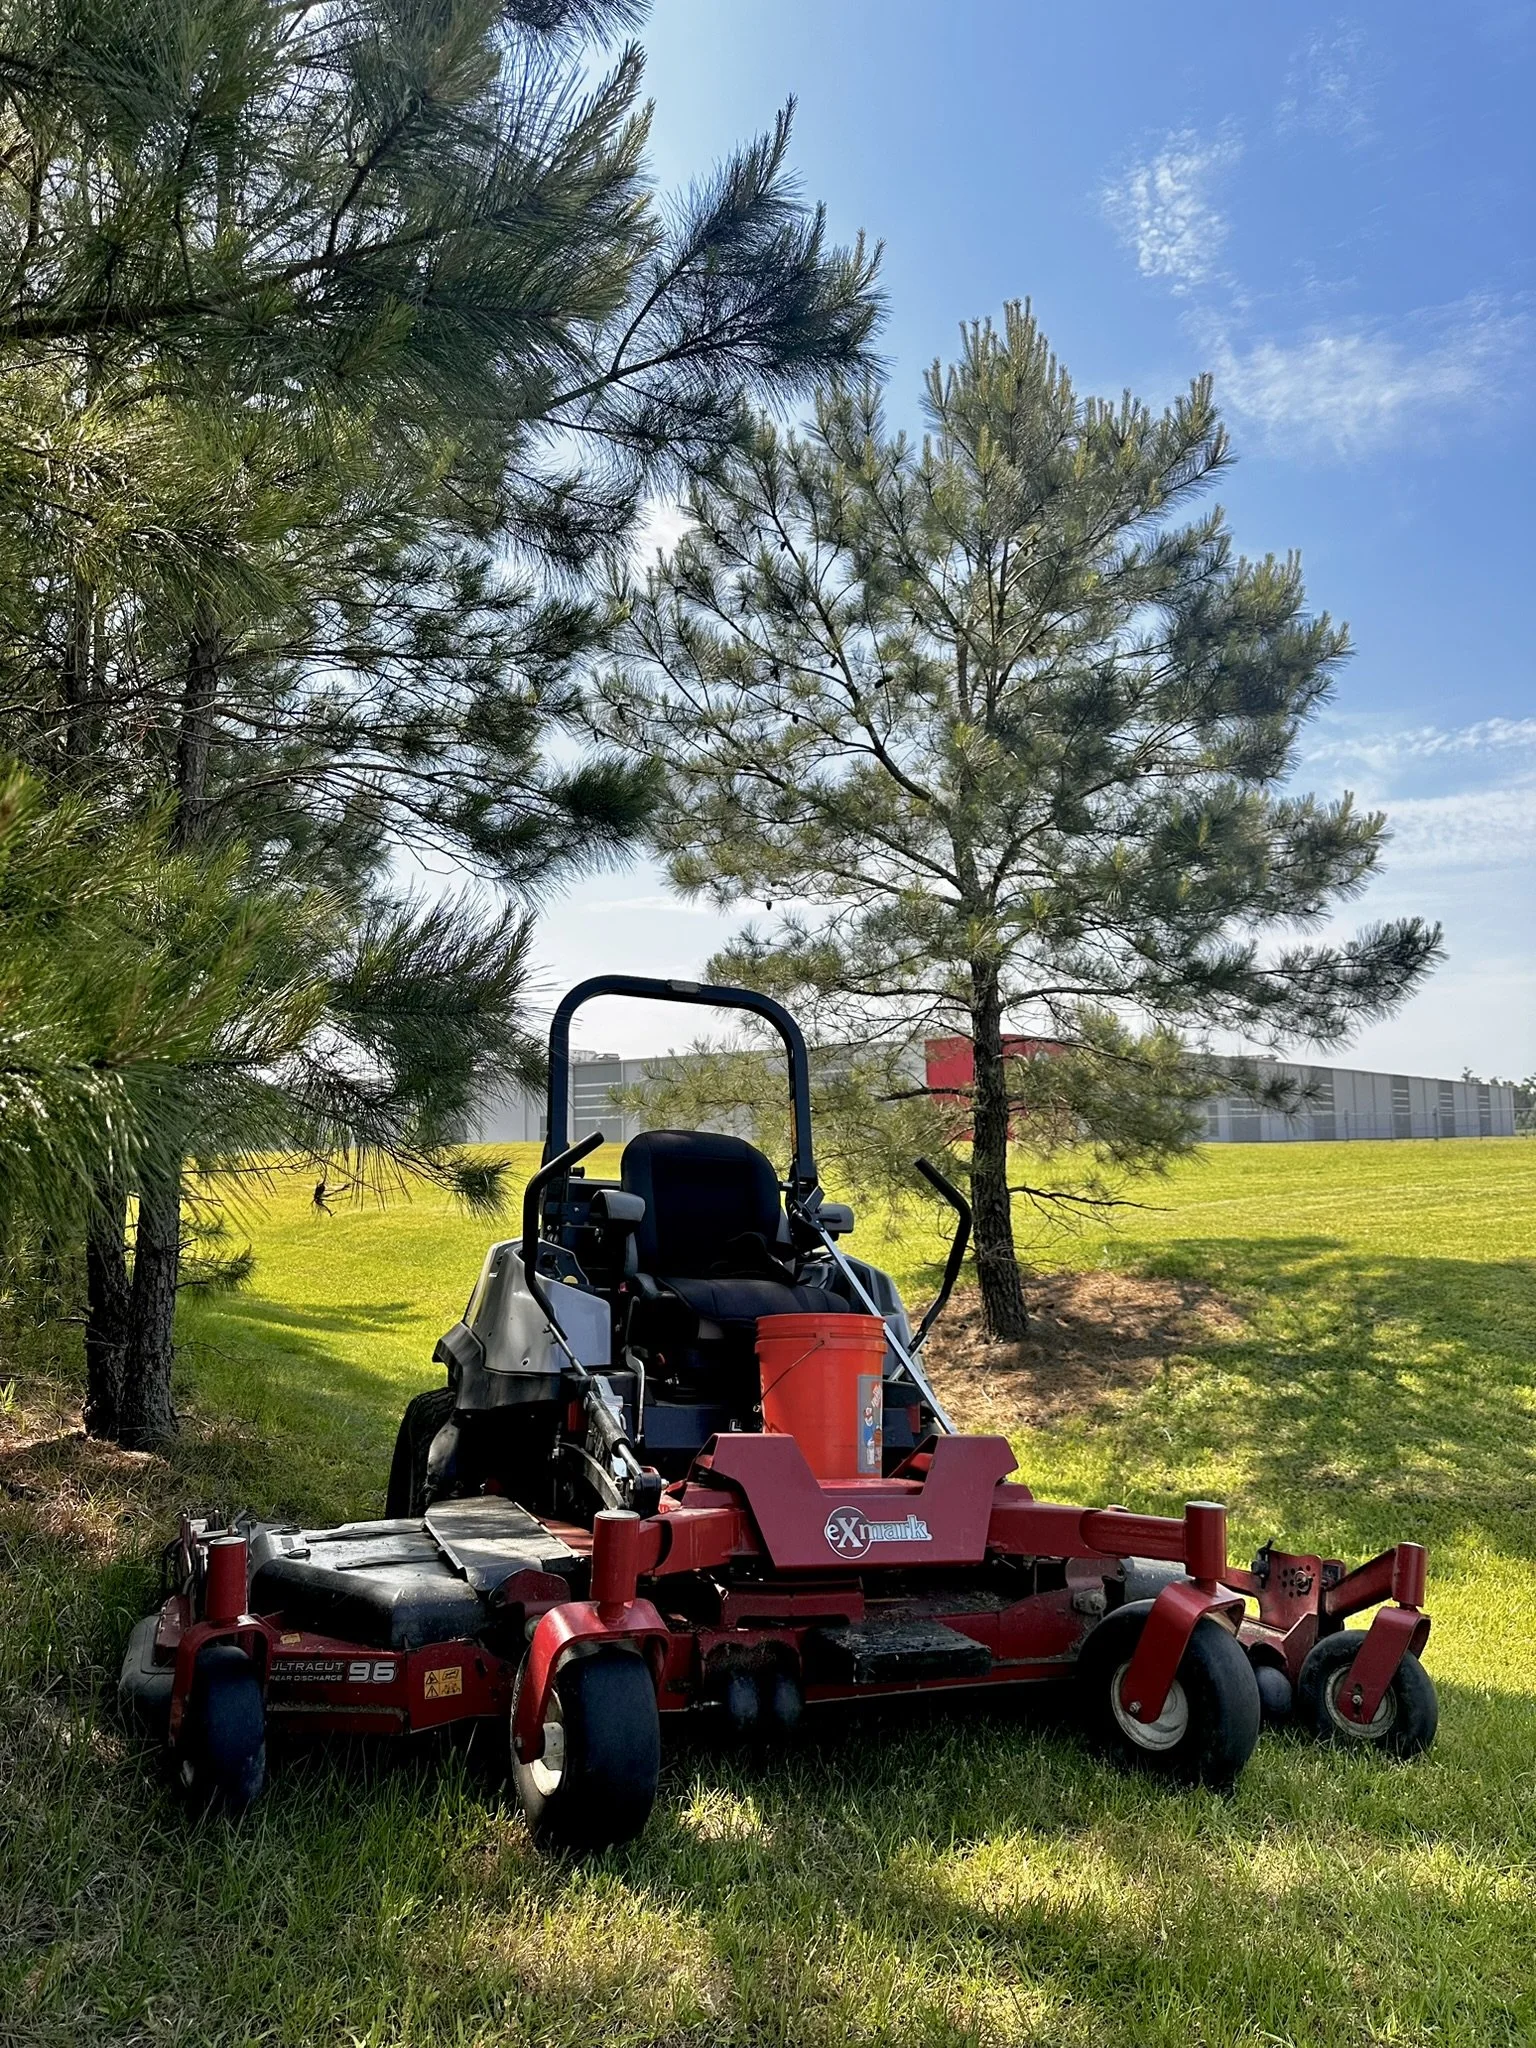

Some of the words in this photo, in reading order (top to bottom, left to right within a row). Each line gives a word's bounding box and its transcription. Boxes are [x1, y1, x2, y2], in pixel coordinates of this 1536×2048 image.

[826, 1515, 928, 1548] eXmark
[269, 1674, 293, 1682] REAR
[293, 1674, 343, 1682] DISCHARGE
[270, 1662, 345, 1671] ULTRACUT
[348, 1662, 395, 1681] 96
